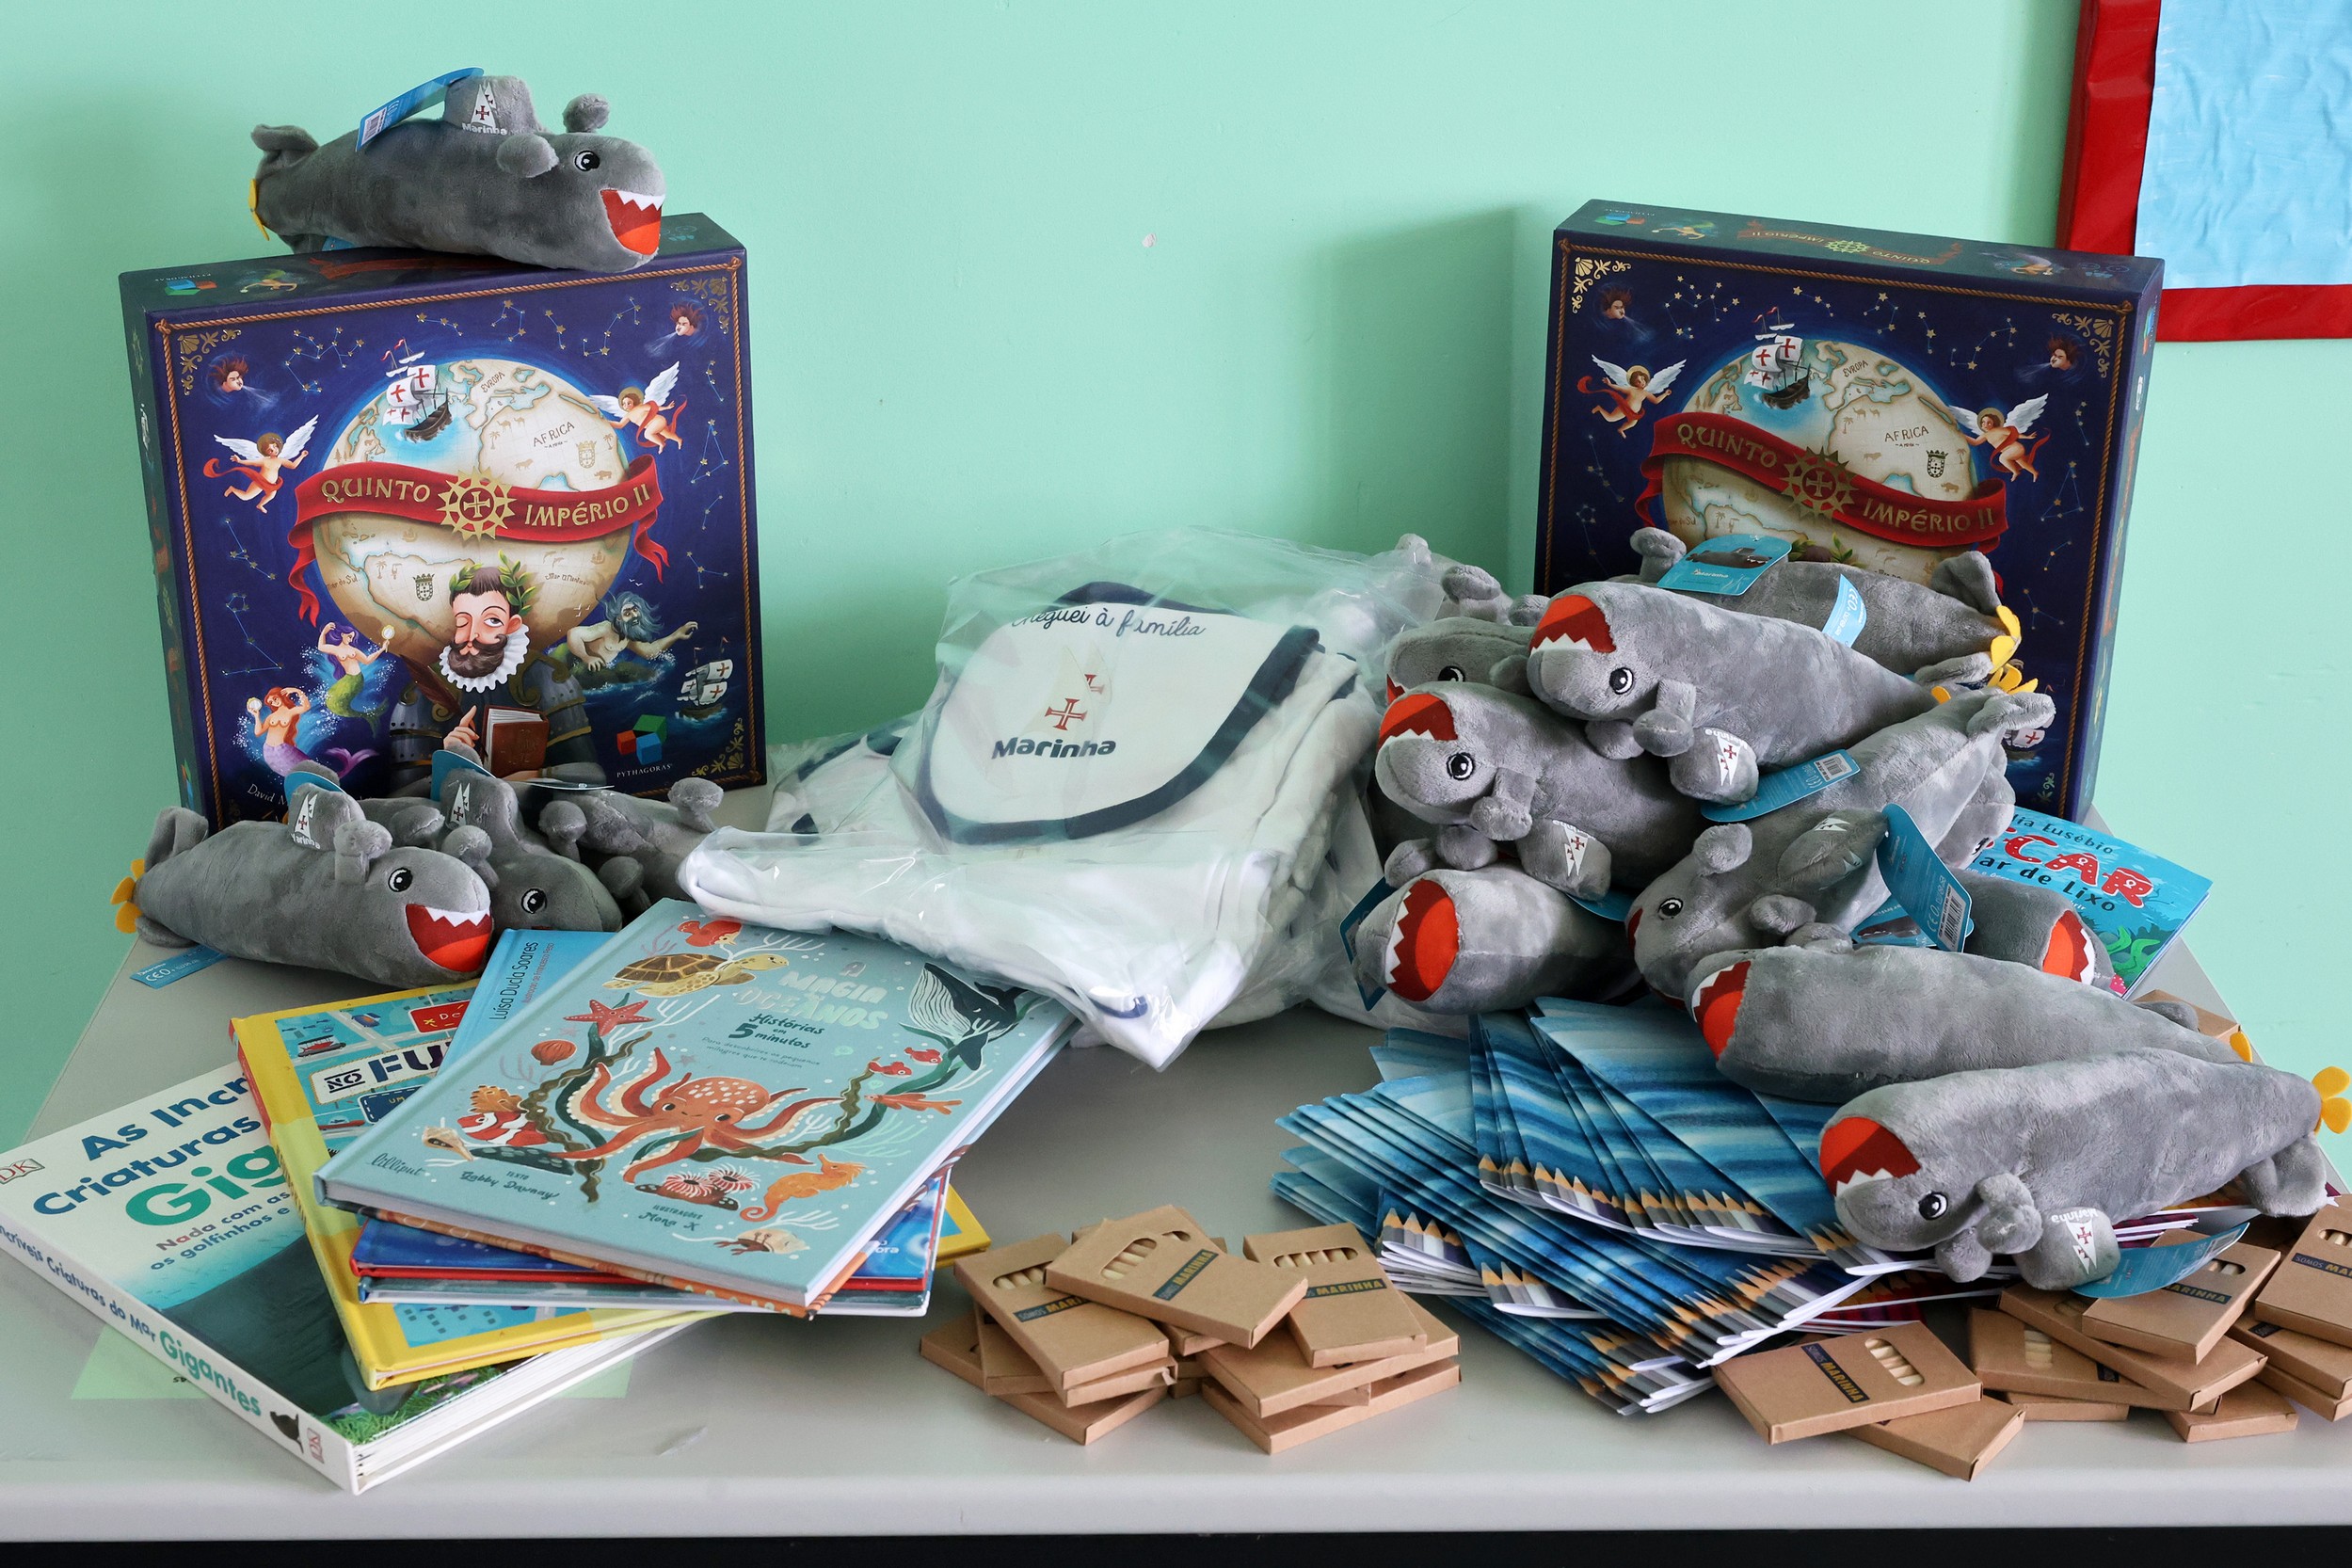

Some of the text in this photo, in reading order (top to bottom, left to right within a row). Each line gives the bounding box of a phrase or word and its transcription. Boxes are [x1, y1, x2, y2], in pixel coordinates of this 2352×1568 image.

[462, 122, 508, 136] Marinha
[533, 421, 575, 447] AFRICA
[1884, 425, 1929, 442] AFRICA
[1677, 424, 1994, 533] QUINTO IMPÉRIO II
[321, 477, 650, 527] QUINTO IMPÉRIO II
[1012, 607, 1091, 630] eguei
[1096, 607, 1114, 627] à
[991, 737, 1116, 760] Marinha
[616, 763, 670, 778] PYTHAGORAS
[247, 783, 275, 803] David
[2042, 824, 2113, 854] Eusébio
[1973, 855, 2011, 870] ar
[2020, 867, 2052, 886] de
[2063, 881, 2115, 912] Lixo
[489, 942, 538, 1020] Luísa Ducla Soares
[778, 970, 888, 1004] MAGIA
[728, 1022, 811, 1049] 5 minutos
[748, 1013, 825, 1035] Histórias
[327, 1041, 452, 1091] NO FU
[81, 1074, 249, 1160] As Incr
[33, 1116, 262, 1215] Criaturas
[371, 1153, 424, 1176] lilliput
[505, 1170, 530, 1180] TEXTO
[460, 1171, 560, 1200] Gabby Dawnay
[156, 1192, 291, 1251] Nada com as
[638, 1211, 677, 1227] Mona
[2051, 1208, 2099, 1224] Marinha
[151, 1257, 175, 1271] os
[180, 1214, 273, 1259] golfinhos
[1173, 1251, 1215, 1286] MARINHA
[1316, 1280, 1383, 1295] MARINHA
[2167, 1284, 2226, 1303] ARINHA
[0, 1225, 262, 1416] ncríveis Criaturas do Mar Gigantes
[1821, 1362, 1864, 1400] MARINHA
